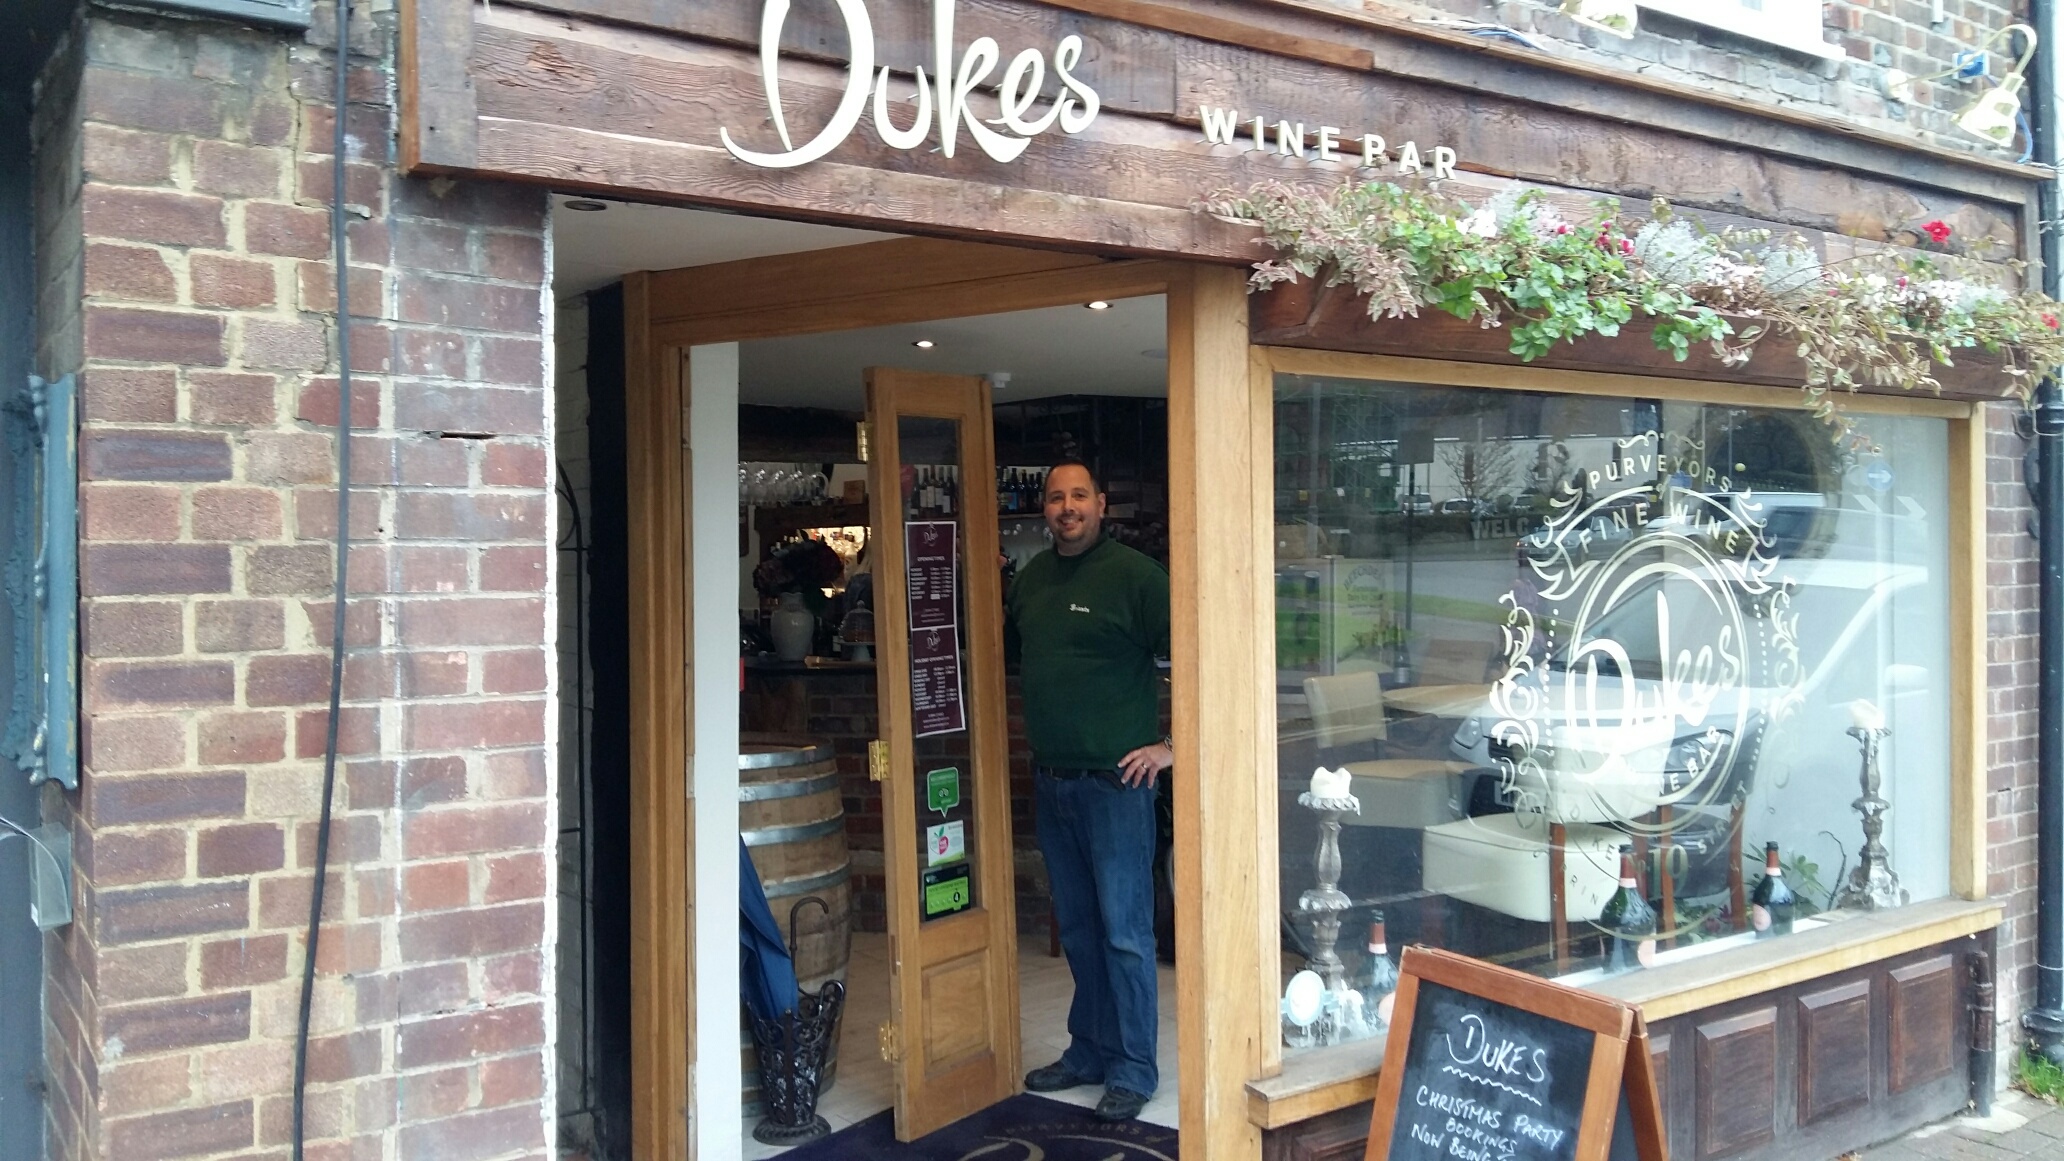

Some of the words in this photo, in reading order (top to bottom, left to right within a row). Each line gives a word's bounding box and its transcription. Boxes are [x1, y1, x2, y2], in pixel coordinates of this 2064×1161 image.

[719, 0, 1101, 169] Dukes
[1198, 104, 1341, 162] WINE
[1363, 133, 1457, 180] BAR
[1589, 454, 1731, 493] PURVEYORS
[1579, 503, 1649, 553] FINE
[1670, 502, 1740, 554] WINE
[1568, 590, 1740, 781] Dukes
[1686, 725, 1720, 780] BAR
[1697, 780, 1747, 855] STRET
[1446, 1014, 1546, 1083] DUKES
[1411, 1123, 1445, 1149] NOW
[1416, 1085, 1502, 1129] CHRISTMAS
[1513, 1114, 1564, 1151] PARTY
[1446, 1117, 1518, 1154] BOOKINGS
